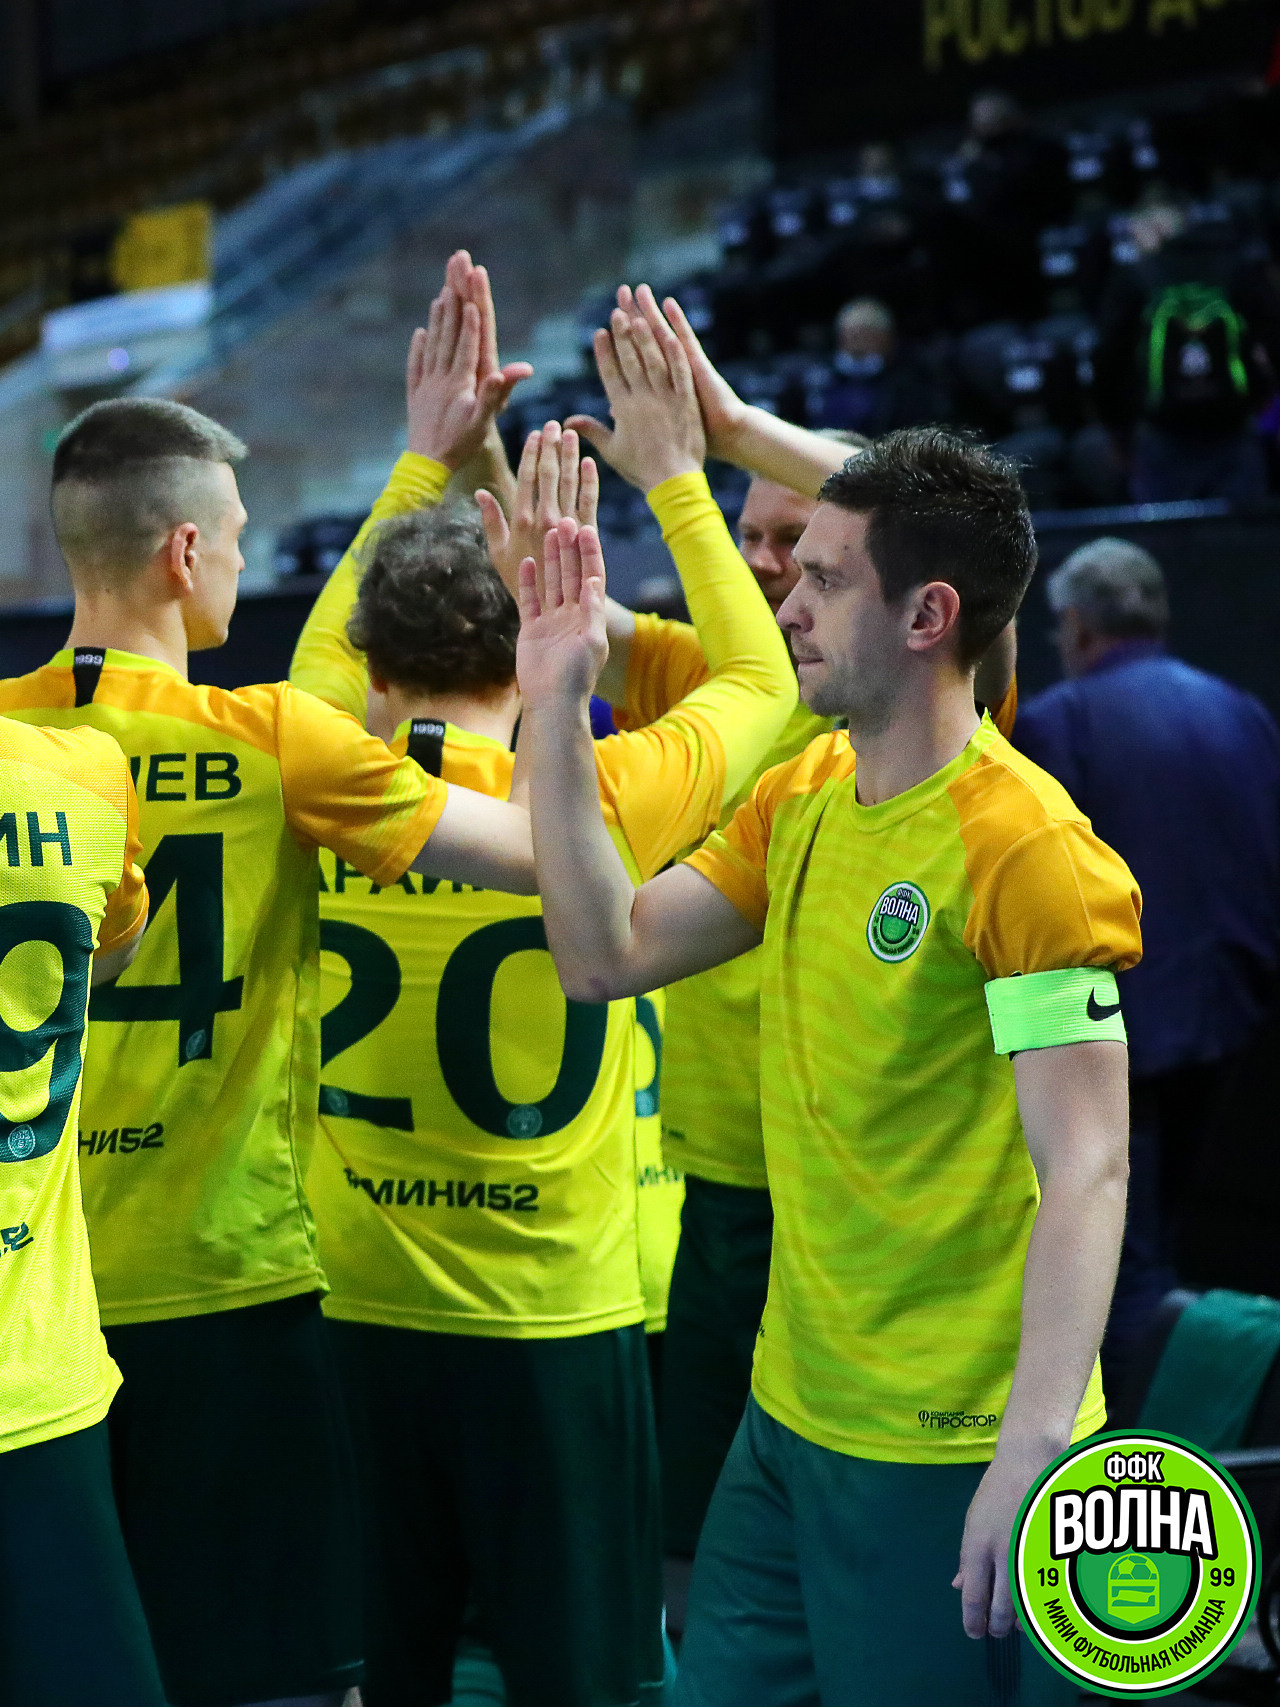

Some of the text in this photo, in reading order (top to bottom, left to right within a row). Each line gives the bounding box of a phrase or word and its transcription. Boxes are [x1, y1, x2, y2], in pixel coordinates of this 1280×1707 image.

[413, 723, 444, 735] 1999
[880, 896, 919, 925] ВОЛНА
[320, 916, 608, 1139] 20
[931, 1414, 997, 1428] ПРОСТОР
